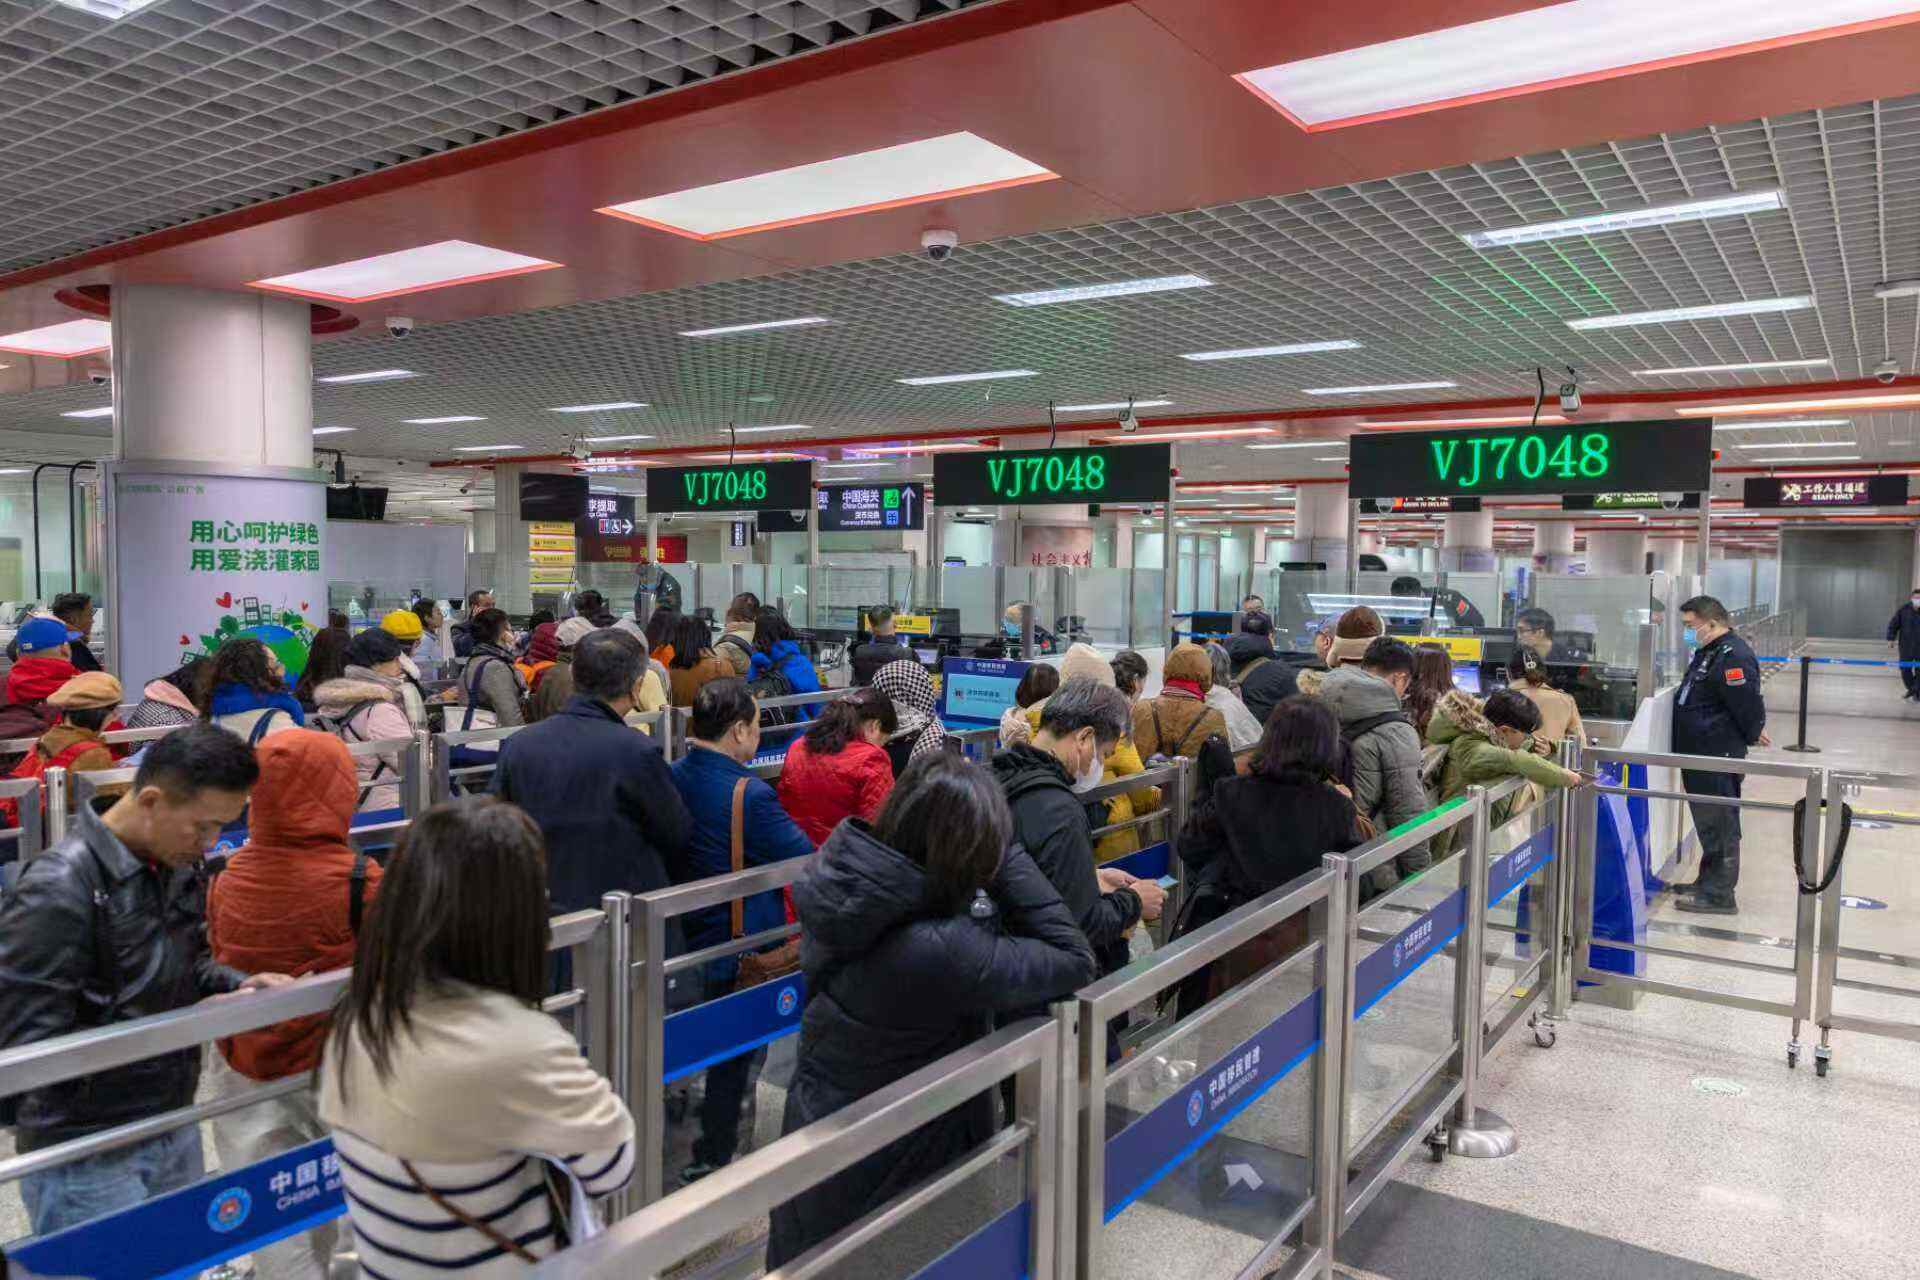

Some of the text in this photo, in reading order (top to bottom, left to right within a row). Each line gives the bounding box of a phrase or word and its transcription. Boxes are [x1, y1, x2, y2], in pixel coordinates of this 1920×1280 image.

[1430, 432, 1610, 488] VJ7048
[684, 469, 767, 506] VJ7048
[987, 454, 1105, 498] VJ7048
[1802, 482, 1864, 494] 工作人员通道
[842, 489, 880, 503] 中国海关
[189, 519, 321, 545] 用心呵护绿色
[190, 547, 321, 572] 用爱浇灌家园
[276, 1183, 320, 1211] CHINA
